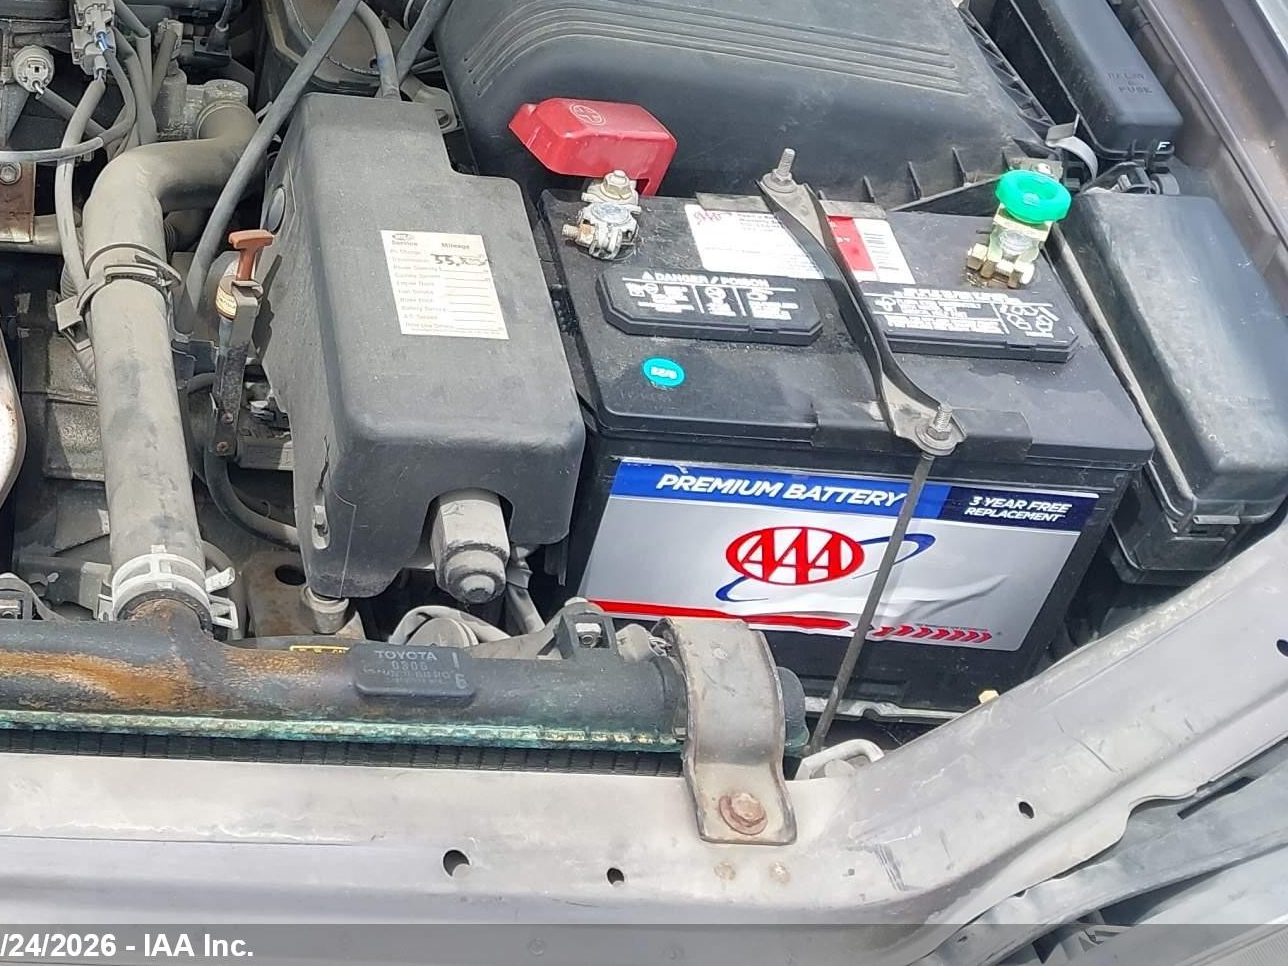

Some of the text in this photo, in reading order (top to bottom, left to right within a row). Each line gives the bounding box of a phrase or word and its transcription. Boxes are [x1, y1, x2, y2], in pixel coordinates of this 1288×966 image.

[1156, 141, 1171, 151] F
[656, 474, 907, 508] PREMIUM BATTERY
[964, 506, 1063, 522] REPLACEMENT
[969, 496, 1073, 515] 3 YEAR FREE
[736, 527, 854, 586] AAA
[374, 650, 438, 661] TOYOTA
